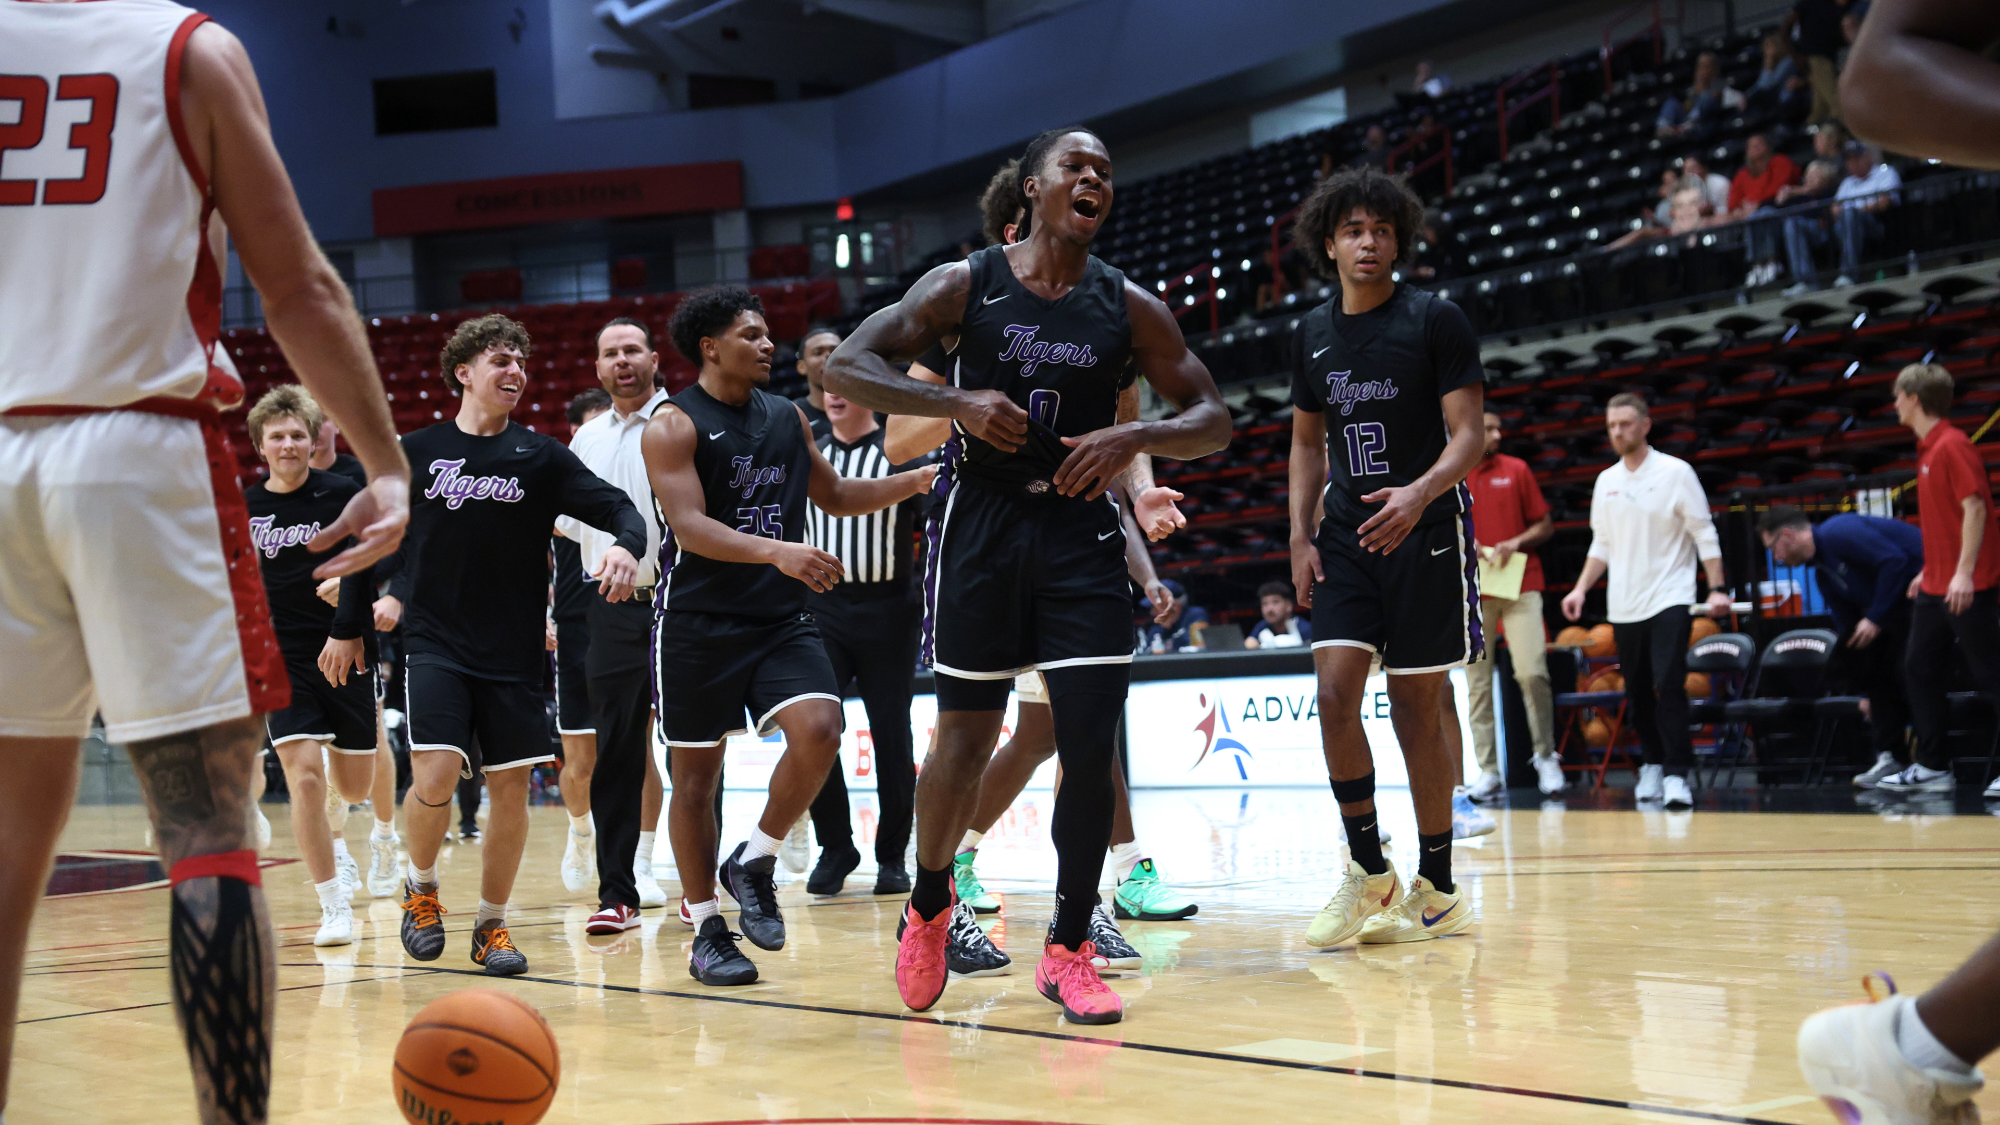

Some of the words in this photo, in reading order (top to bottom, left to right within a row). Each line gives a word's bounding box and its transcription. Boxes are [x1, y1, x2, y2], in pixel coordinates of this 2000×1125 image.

[0, 72, 120, 206] 23
[456, 183, 642, 213] CONCESSIONS
[999, 323, 1098, 377] Tigers
[1029, 388, 1061, 431] 0
[1326, 369, 1399, 416] Tigers
[1343, 421, 1390, 477] 12
[424, 457, 525, 510] Tigers
[736, 503, 783, 541] 25
